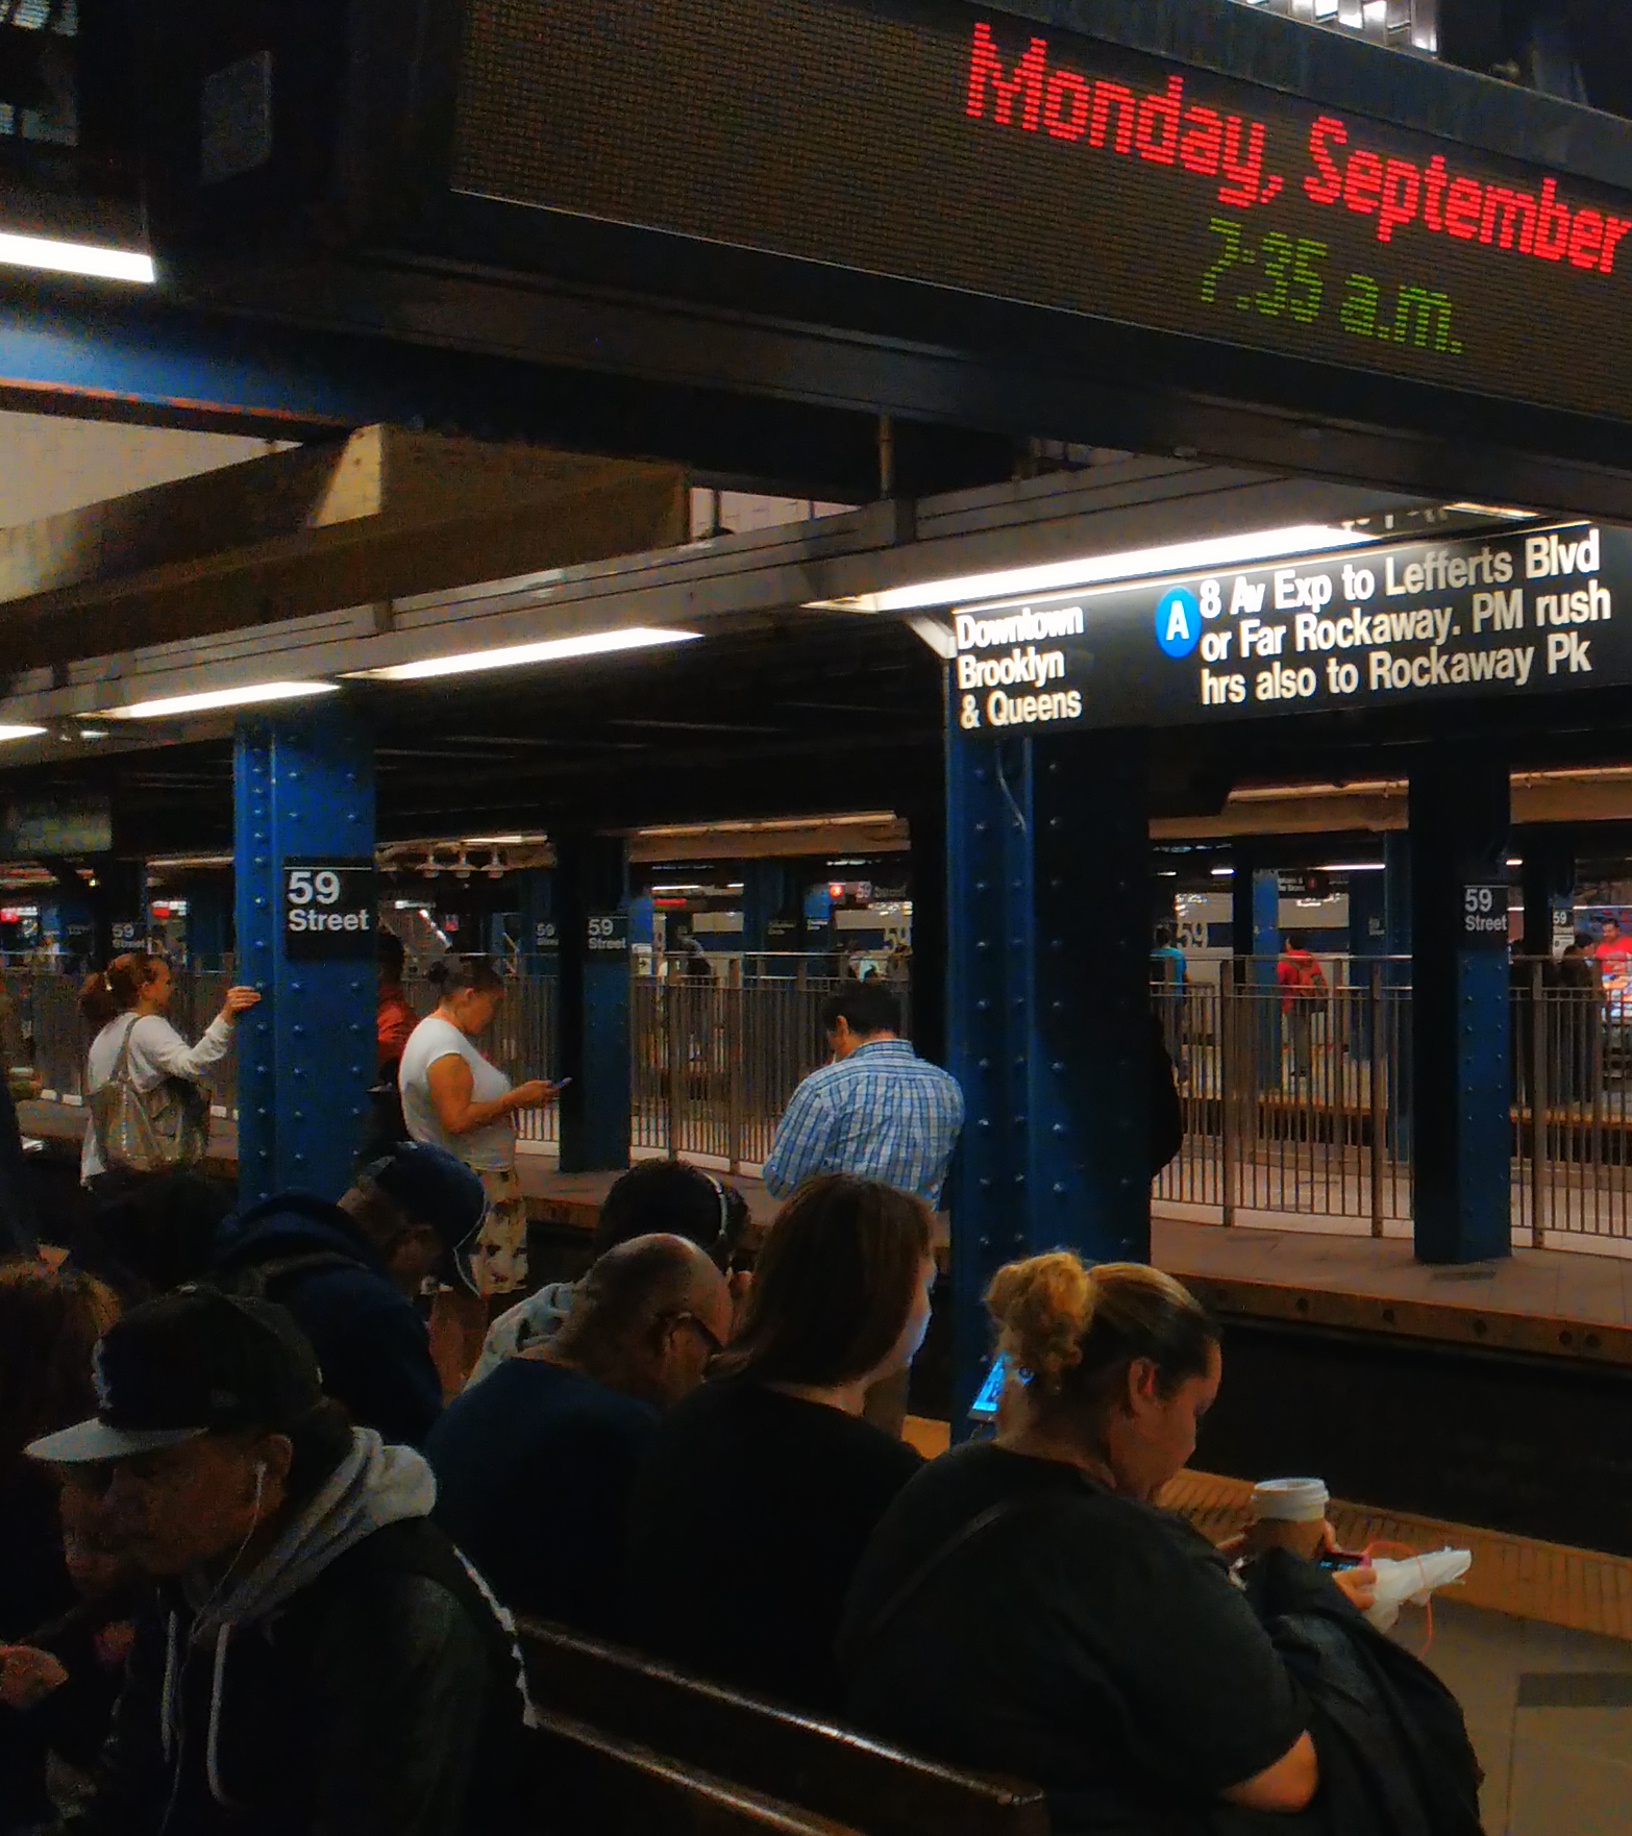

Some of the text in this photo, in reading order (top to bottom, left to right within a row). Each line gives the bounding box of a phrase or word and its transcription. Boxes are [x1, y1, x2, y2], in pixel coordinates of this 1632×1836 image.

[966, 24, 1282, 206] Monday,
[1304, 117, 1632, 273] September
[1201, 217, 1462, 354] 7:35 a.m.
[1200, 528, 1601, 619] 8 Av Exp to Lefferts Blvd
[955, 605, 1085, 650] Downtown
[1166, 600, 1190, 641] A
[1200, 579, 1611, 662] or Far Rockaway. PM rush
[957, 647, 1065, 690] Brooklyn
[1201, 631, 1592, 705] hrs also to Rockaway Pk
[960, 690, 1082, 730] & Queens
[287, 870, 341, 905] 59
[1465, 889, 1492, 912] 59
[112, 923, 135, 938] 59
[288, 908, 370, 932] Street
[588, 919, 613, 936] 59
[1177, 920, 1208, 948] 59
[1465, 915, 1507, 932] Street
[1553, 912, 1567, 925] 59
